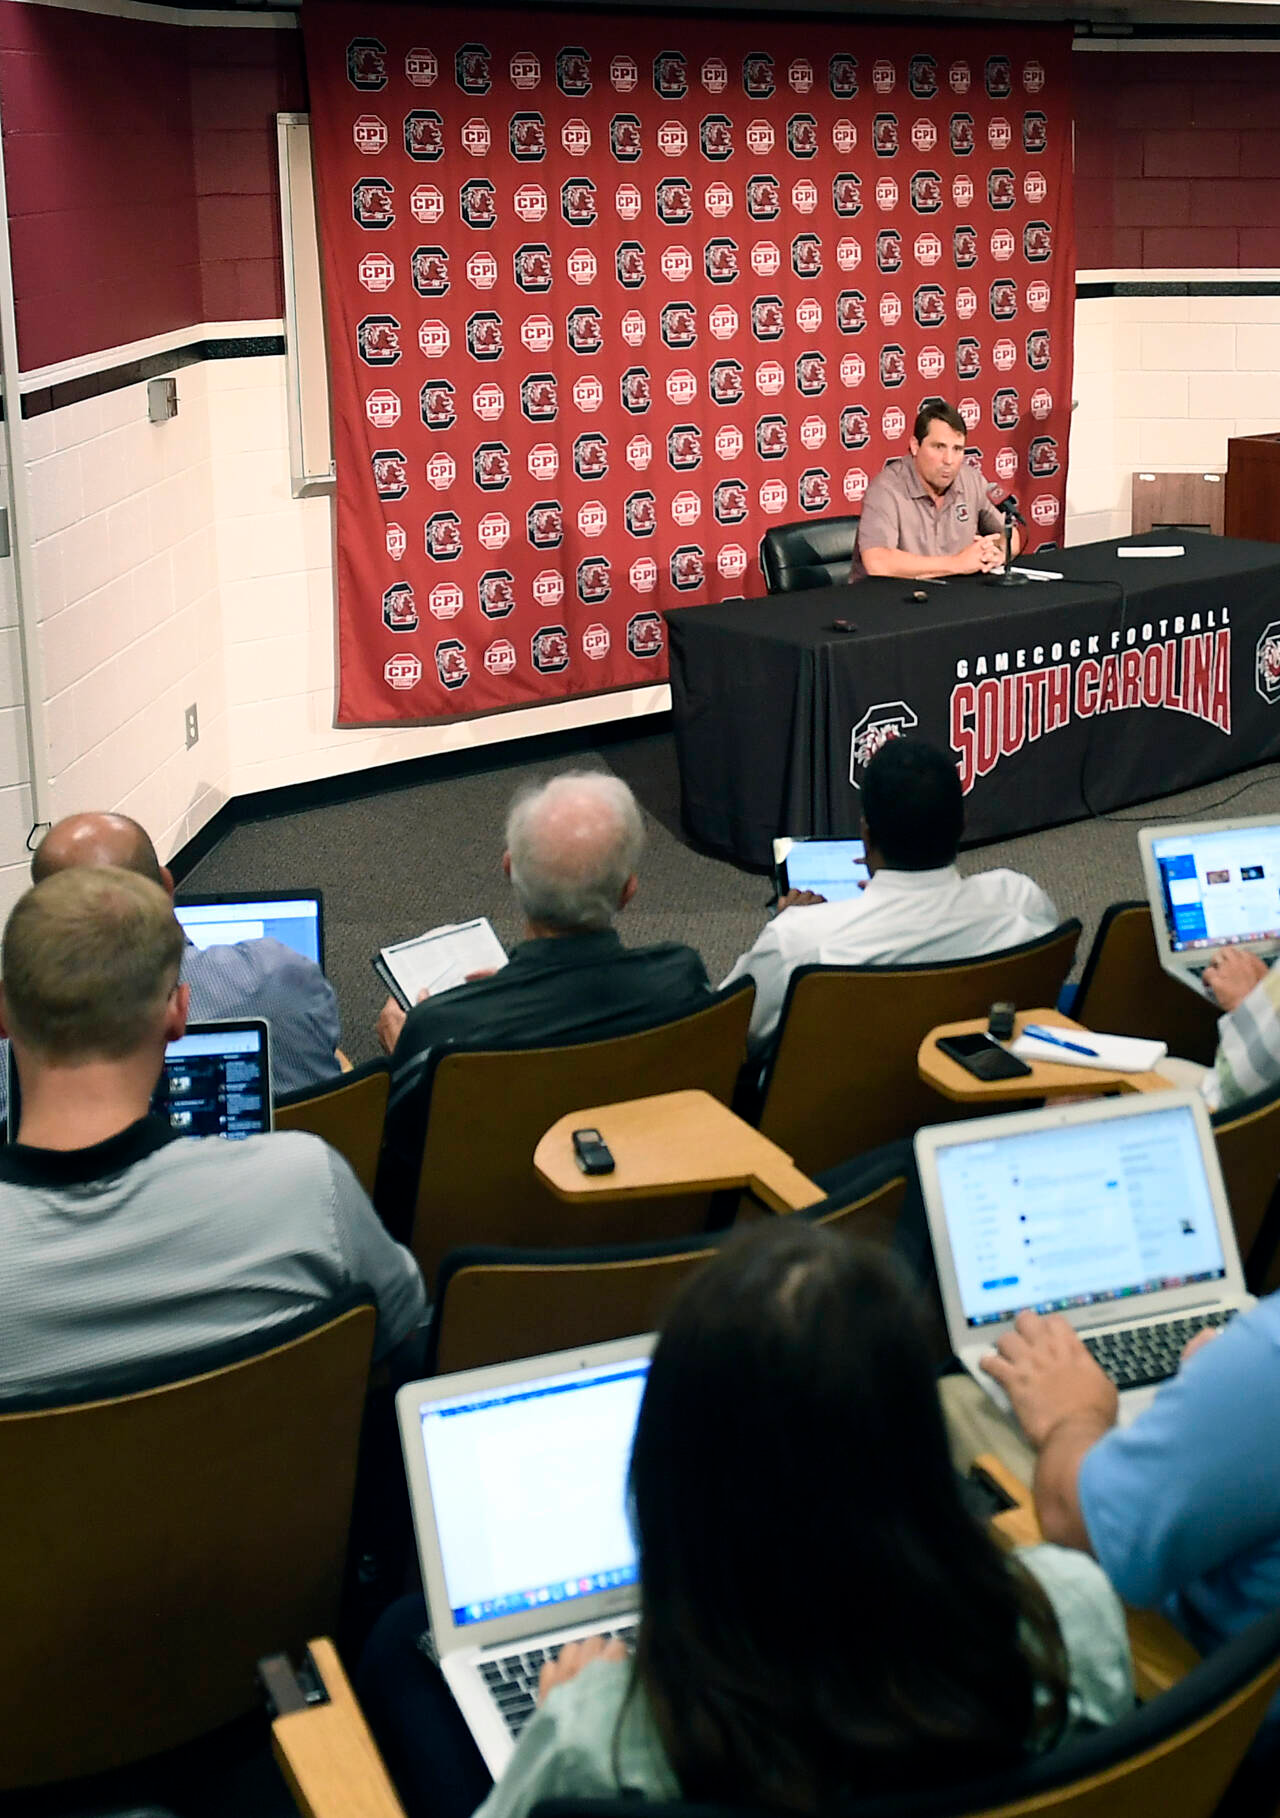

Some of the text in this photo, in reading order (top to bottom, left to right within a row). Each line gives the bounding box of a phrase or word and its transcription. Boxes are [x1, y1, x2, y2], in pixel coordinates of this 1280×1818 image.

[407, 60, 436, 74] CPI
[512, 64, 539, 76] CPI
[612, 67, 636, 79] CPI
[704, 70, 725, 81] CPI
[790, 70, 811, 81] CPI
[873, 71, 894, 82] CPI
[951, 71, 969, 83] CPI
[1024, 71, 1043, 83] CPI
[356, 128, 384, 140] CPI
[465, 131, 488, 143] CPI
[565, 131, 588, 143] CPI
[661, 133, 685, 144] CPI
[749, 132, 772, 142] CPI
[835, 131, 854, 141] CPI
[914, 129, 934, 140] CPI
[990, 128, 1009, 138] CPI
[953, 186, 971, 196] CPI
[1025, 182, 1044, 192] CPI
[795, 191, 815, 202] CPI
[877, 188, 896, 199] CPI
[414, 198, 441, 210] CPI
[517, 197, 545, 209] CPI
[618, 196, 639, 207] CPI
[708, 194, 730, 205] CPI
[917, 244, 938, 254] CPI
[992, 239, 1012, 250] CPI
[754, 253, 777, 264] CPI
[839, 248, 858, 259] CPI
[571, 261, 594, 272] CPI
[664, 258, 689, 269] CPI
[362, 267, 391, 278] CPI
[470, 265, 495, 276] CPI
[1029, 291, 1048, 301] CPI
[881, 304, 898, 314] CPI
[958, 298, 975, 309] CPI
[799, 310, 819, 320] CPI
[712, 316, 735, 327] CPI
[525, 328, 551, 339] CPI
[625, 322, 643, 334] CPI
[421, 333, 447, 344] CPI
[995, 349, 1014, 360] CPI
[920, 357, 942, 368] CPI
[842, 364, 862, 375] CPI
[758, 373, 782, 384] CPI
[669, 381, 694, 392] CPI
[576, 388, 600, 400] CPI
[476, 396, 501, 408] CPI
[1033, 399, 1050, 410] CPI
[369, 402, 397, 414] CPI
[884, 417, 903, 428] CPI
[803, 427, 823, 438] CPI
[718, 437, 740, 448] CPI
[630, 446, 649, 458] CPI
[531, 456, 557, 468] CPI
[998, 457, 1016, 468] CPI
[430, 465, 452, 477] CPI
[846, 479, 865, 490] CPI
[762, 490, 785, 502] CPI
[675, 502, 698, 514] CPI
[1034, 504, 1057, 515] CPI
[581, 513, 604, 525] CPI
[482, 524, 506, 537] CPI
[720, 555, 743, 567] CPI
[633, 569, 655, 581] CPI
[537, 581, 561, 594] CPI
[433, 595, 459, 607] CPI
[586, 635, 607, 648] CPI
[956, 606, 1230, 679] GAMECOCK FOOTBALL
[488, 651, 513, 663] CPI
[388, 666, 418, 677] CPI
[950, 628, 1231, 797] SOUTH CAROLINA
